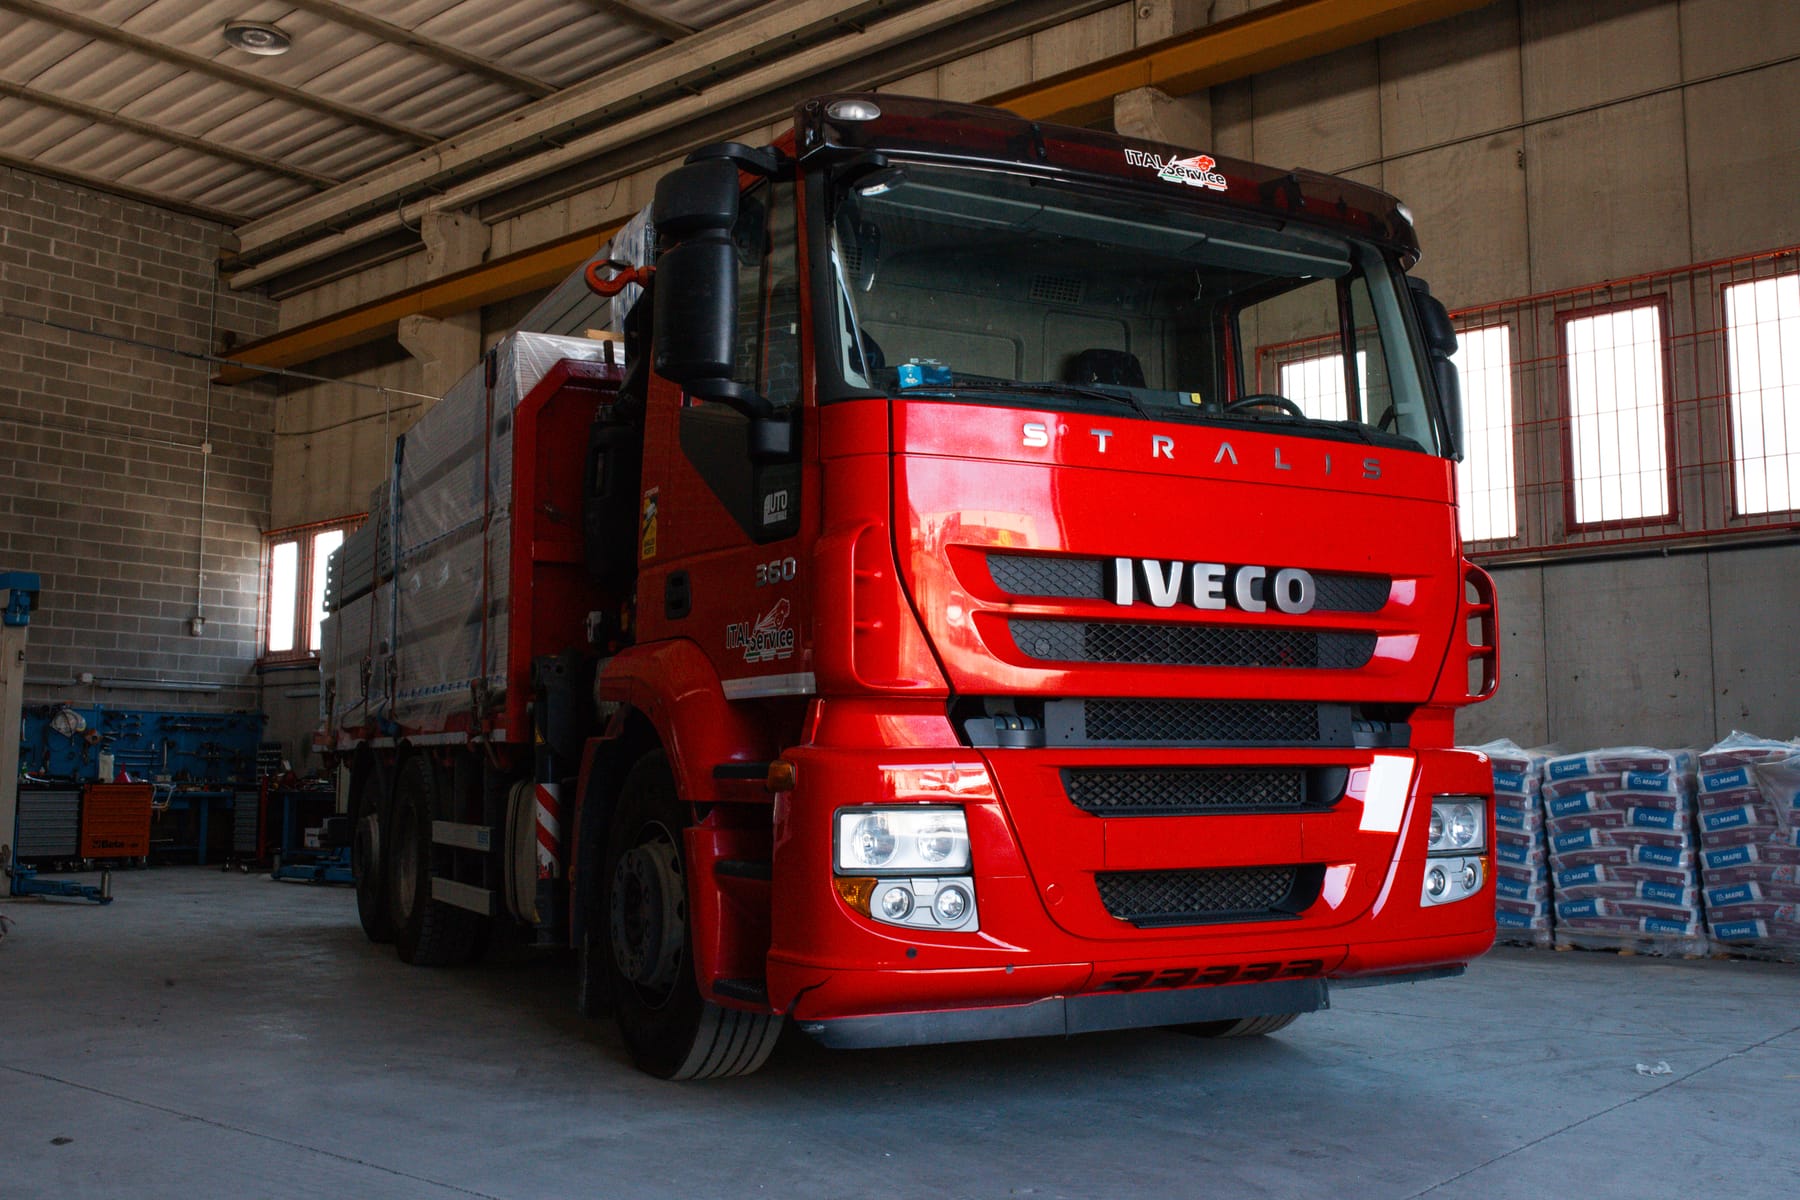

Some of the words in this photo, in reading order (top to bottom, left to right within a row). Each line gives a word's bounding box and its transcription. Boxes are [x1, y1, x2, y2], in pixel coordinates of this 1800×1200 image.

[1124, 148, 1166, 171] ITAL
[1162, 163, 1226, 185] Service
[1023, 422, 1382, 480] STRALIS
[755, 556, 796, 587] 360
[1115, 557, 1316, 614] IVECO
[726, 622, 751, 649] ITAL
[749, 628, 794, 651] Service
